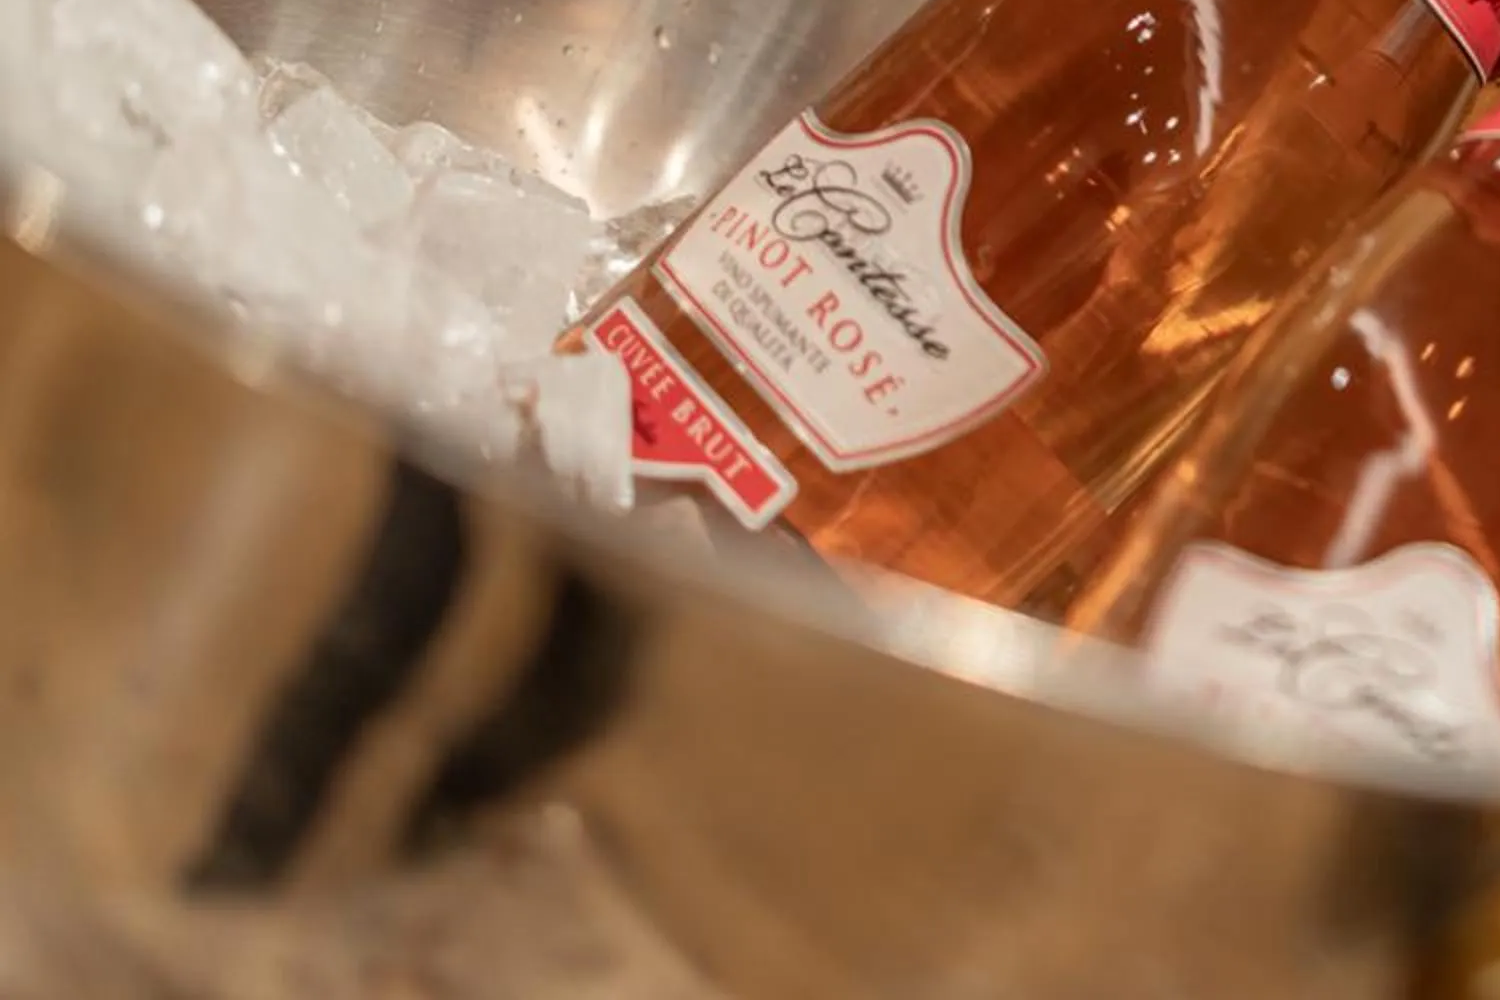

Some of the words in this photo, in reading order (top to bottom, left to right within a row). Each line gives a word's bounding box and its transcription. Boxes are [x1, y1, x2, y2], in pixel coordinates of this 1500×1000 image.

[758, 154, 808, 197] Le
[711, 205, 813, 288] PINOT
[806, 290, 906, 404] ROSÉ
[772, 160, 950, 361] Contesse
[671, 398, 752, 480] BRUT
